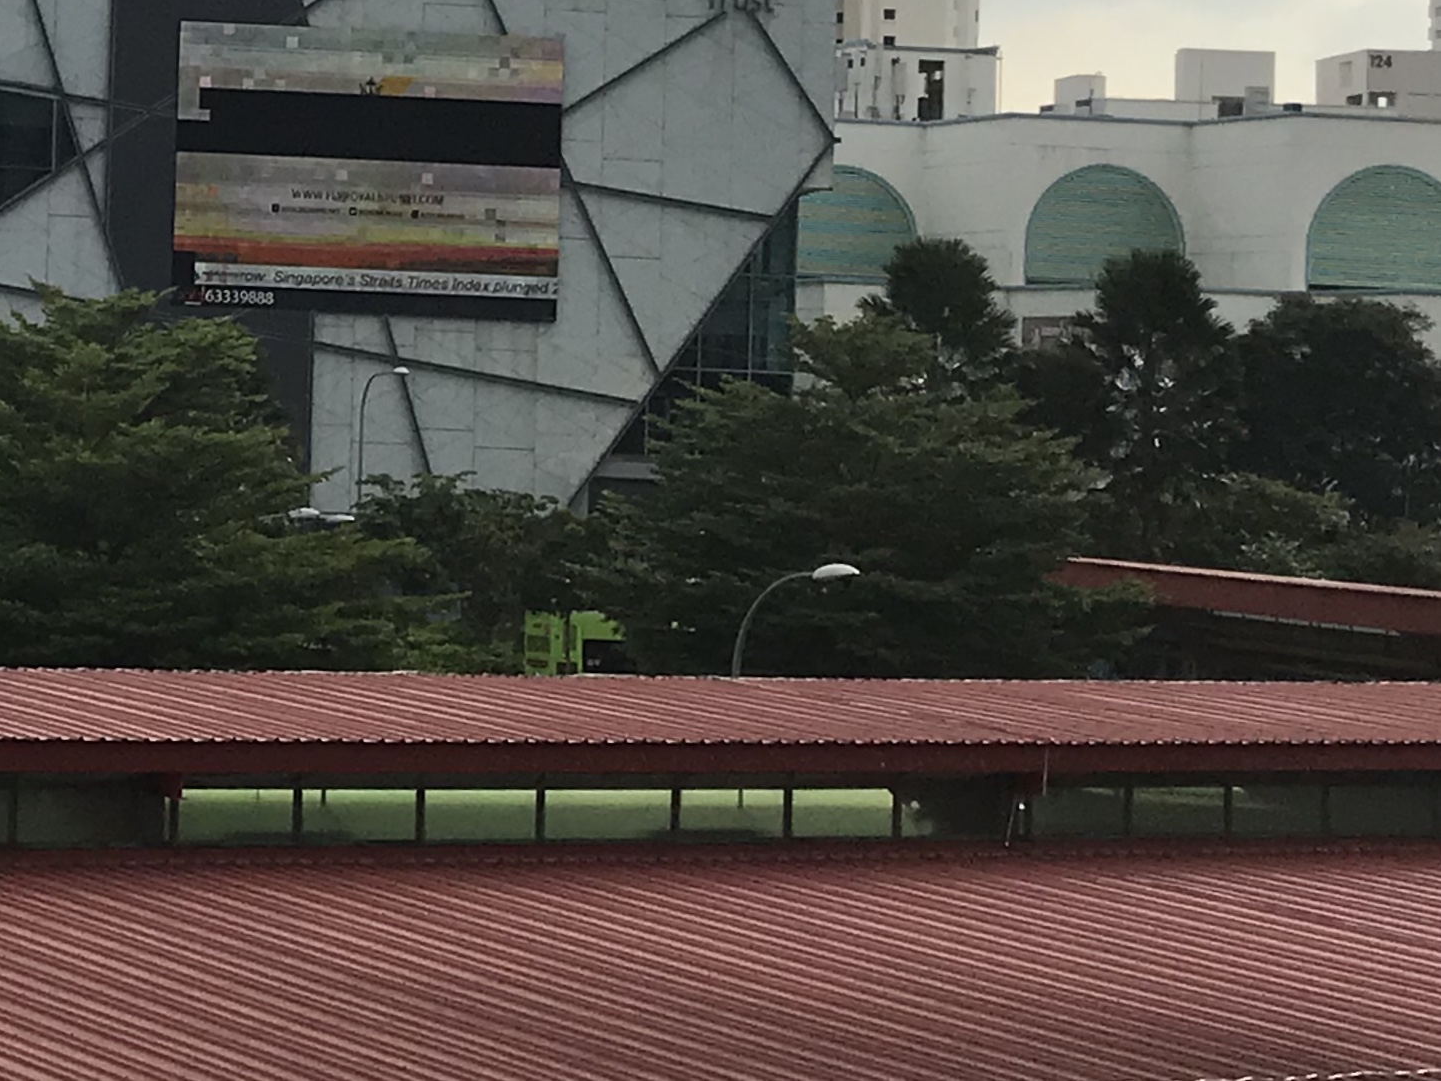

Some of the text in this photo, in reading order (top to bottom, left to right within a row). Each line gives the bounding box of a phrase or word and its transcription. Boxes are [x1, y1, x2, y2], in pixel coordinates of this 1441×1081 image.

[1369, 54, 1393, 69] 124
[273, 270, 356, 288] Singapore's
[359, 273, 403, 289] Straits
[407, 275, 449, 290] Times
[451, 276, 489, 291] Index
[204, 288, 275, 306] 63339888
